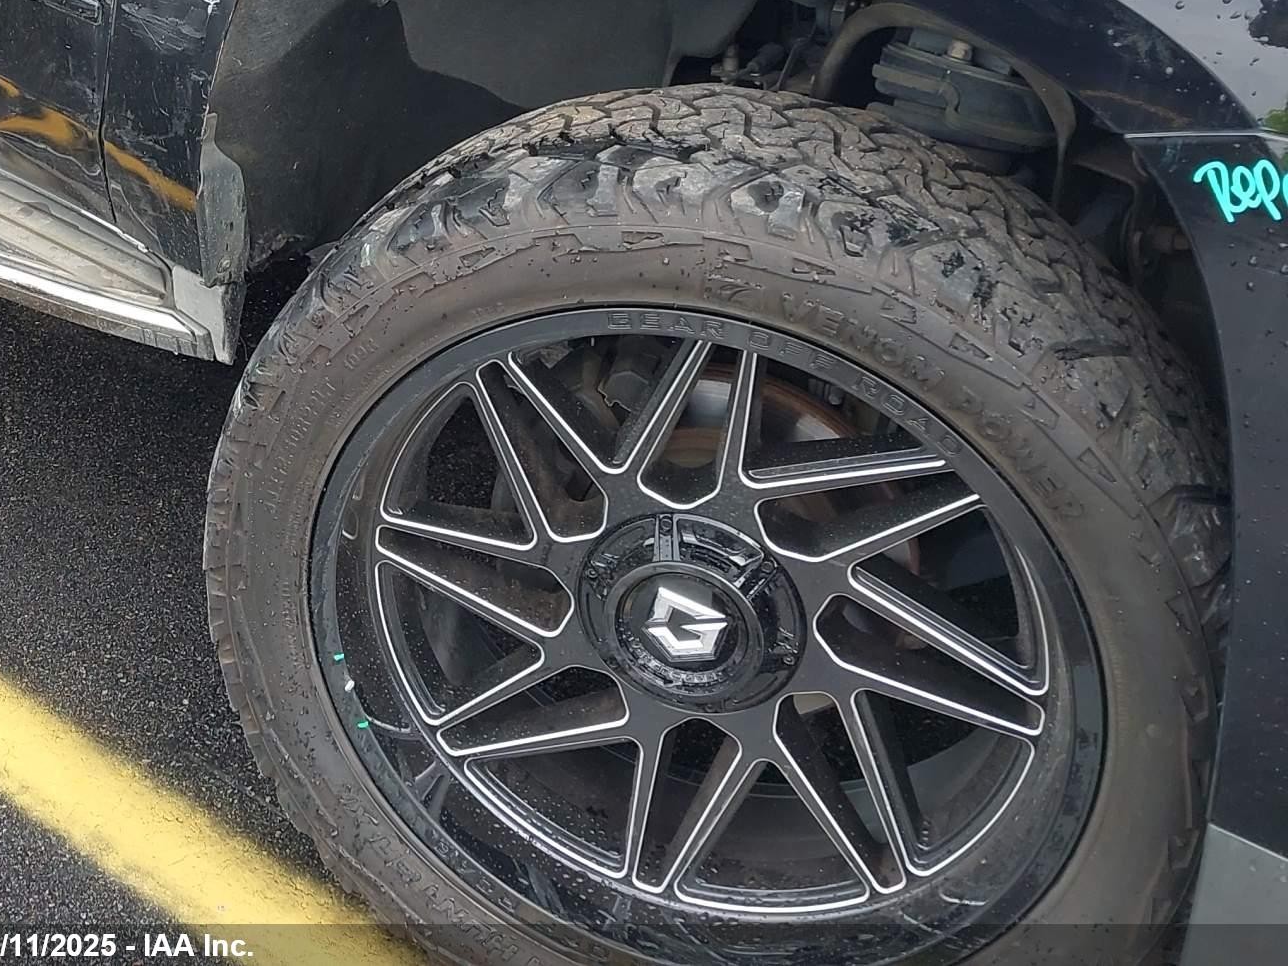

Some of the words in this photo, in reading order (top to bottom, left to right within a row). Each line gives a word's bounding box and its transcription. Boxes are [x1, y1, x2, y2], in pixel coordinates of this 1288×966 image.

[607, 311, 725, 340] GEAR
[747, 330, 837, 369] OFF
[852, 376, 962, 457] ROAD
